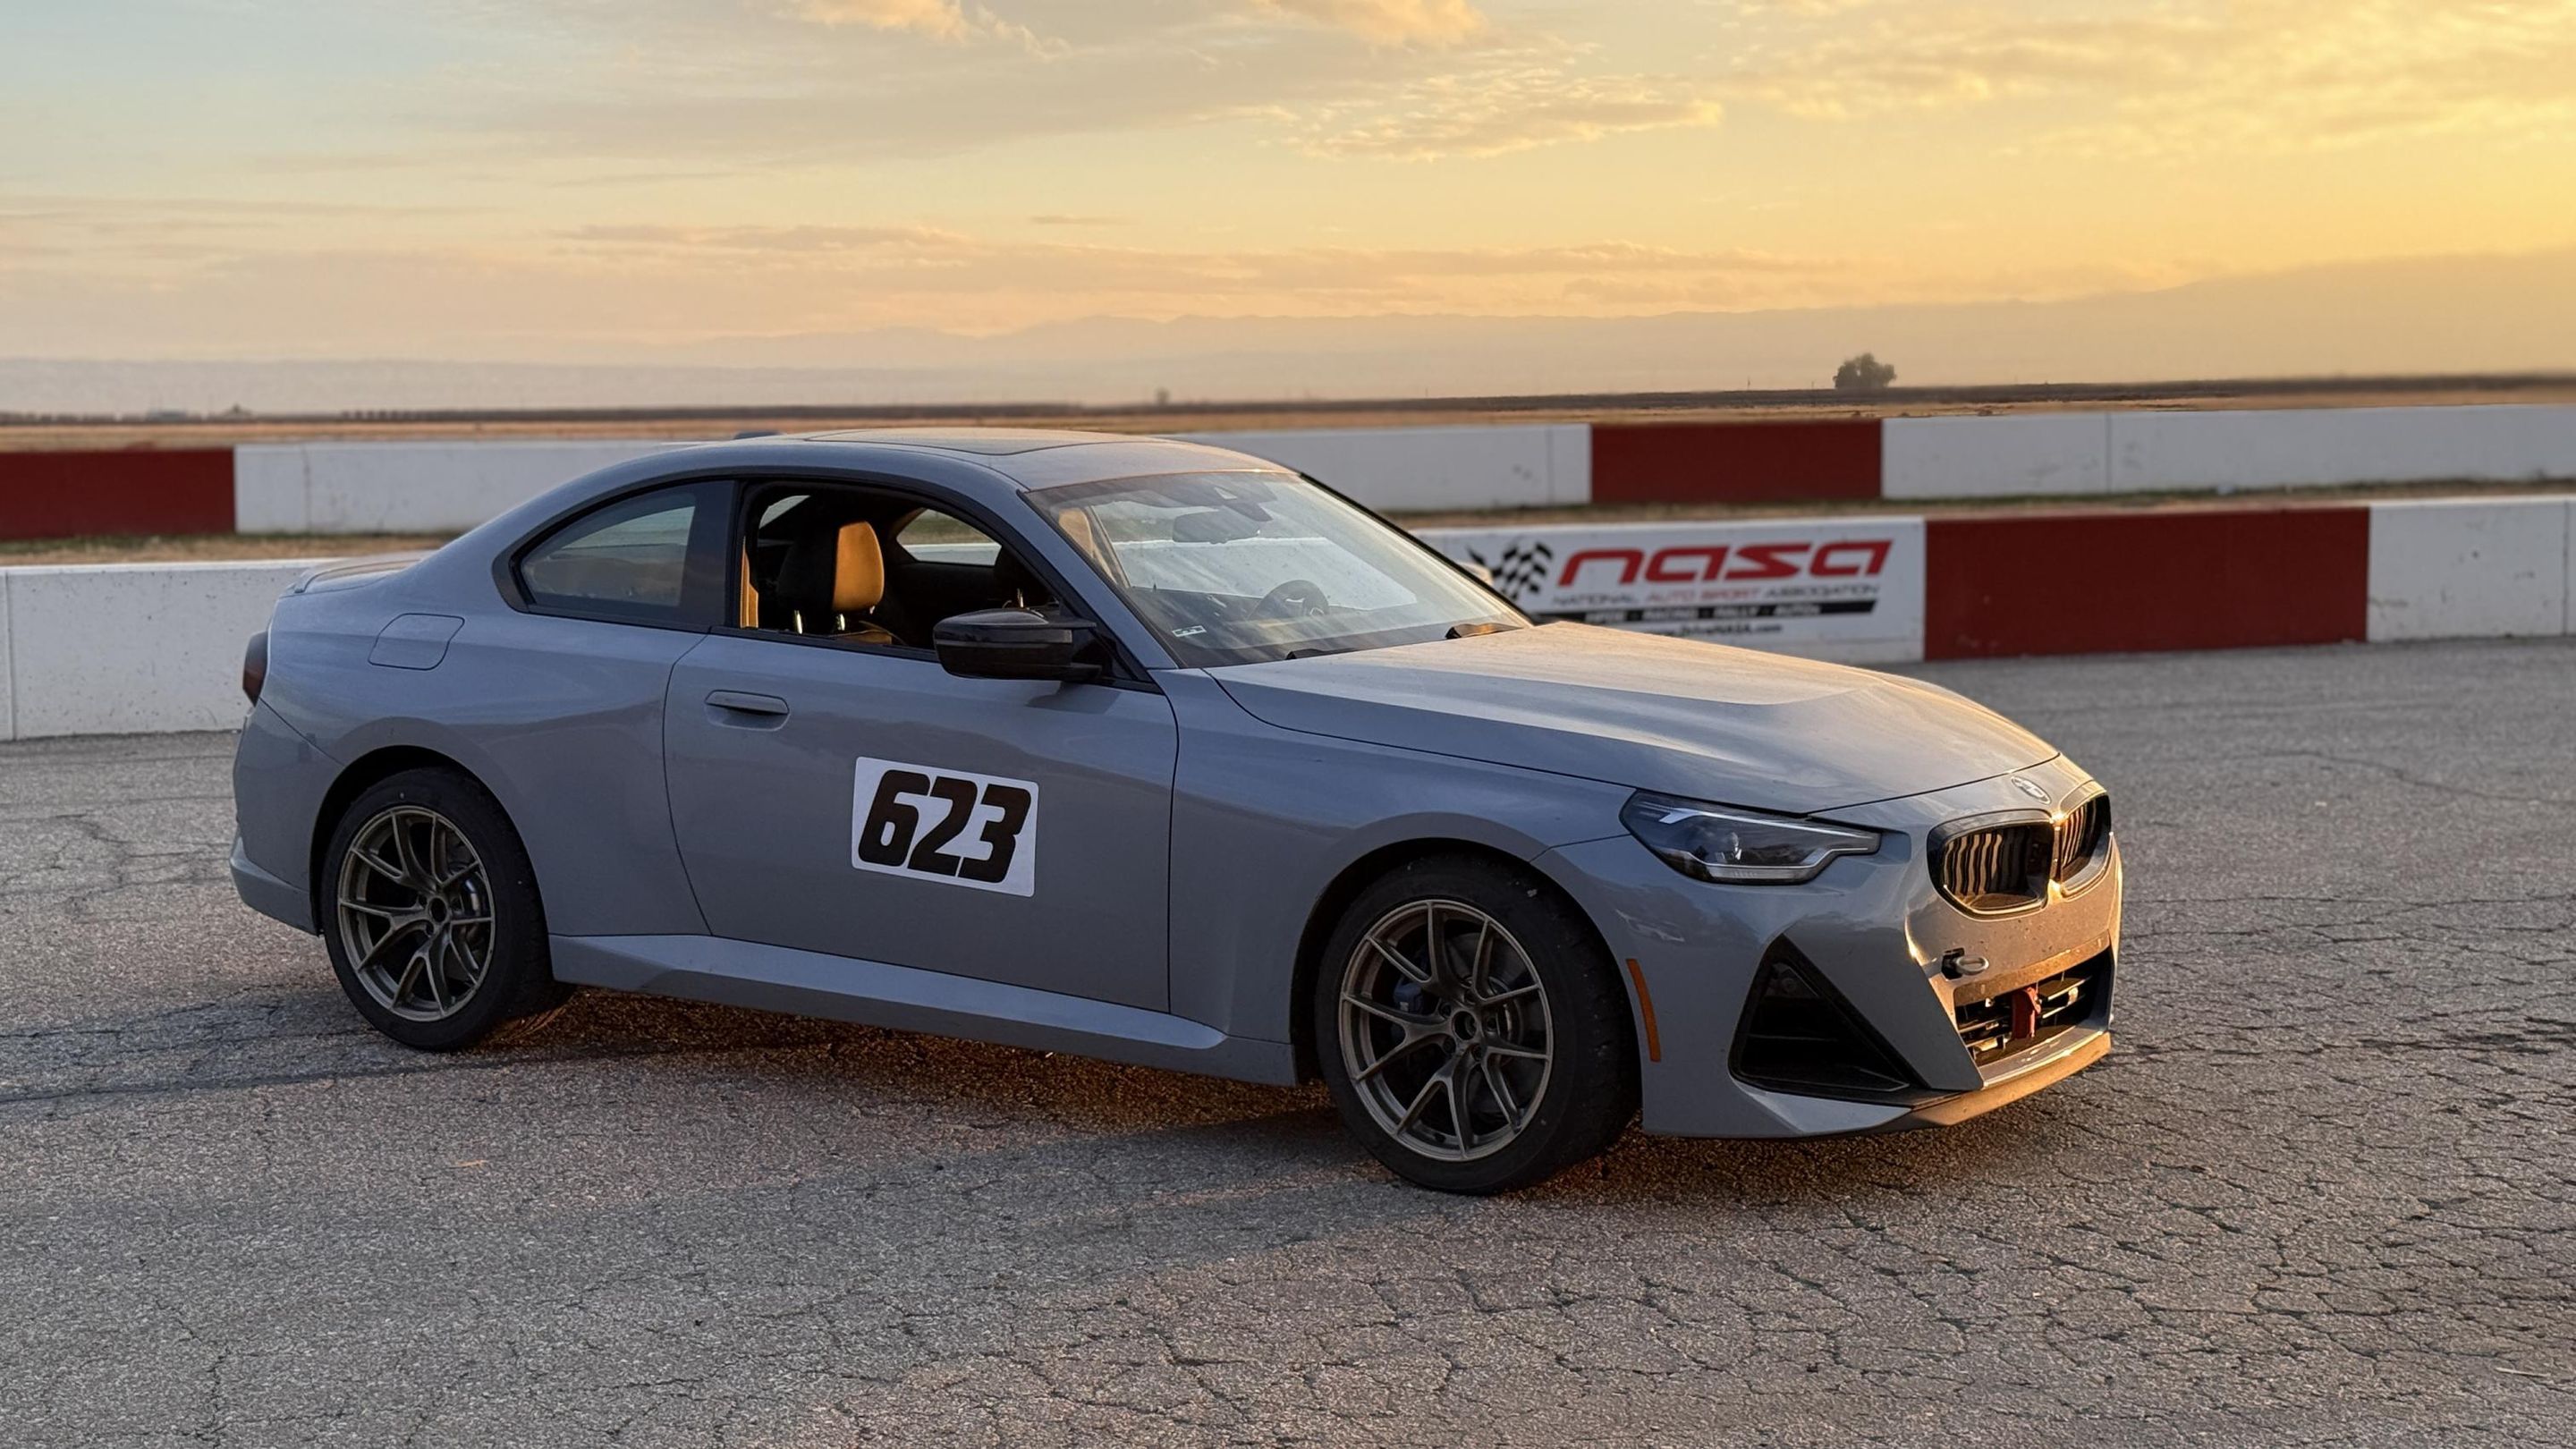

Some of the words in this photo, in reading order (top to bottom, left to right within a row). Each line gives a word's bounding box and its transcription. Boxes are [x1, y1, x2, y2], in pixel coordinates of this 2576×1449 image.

[1552, 594, 1636, 606] NATIONAL
[1646, 590, 1696, 602] AUTO
[1700, 588, 1760, 600] SPORT
[1766, 584, 1880, 597] ASSOCIATION
[859, 769, 1032, 883] 623
